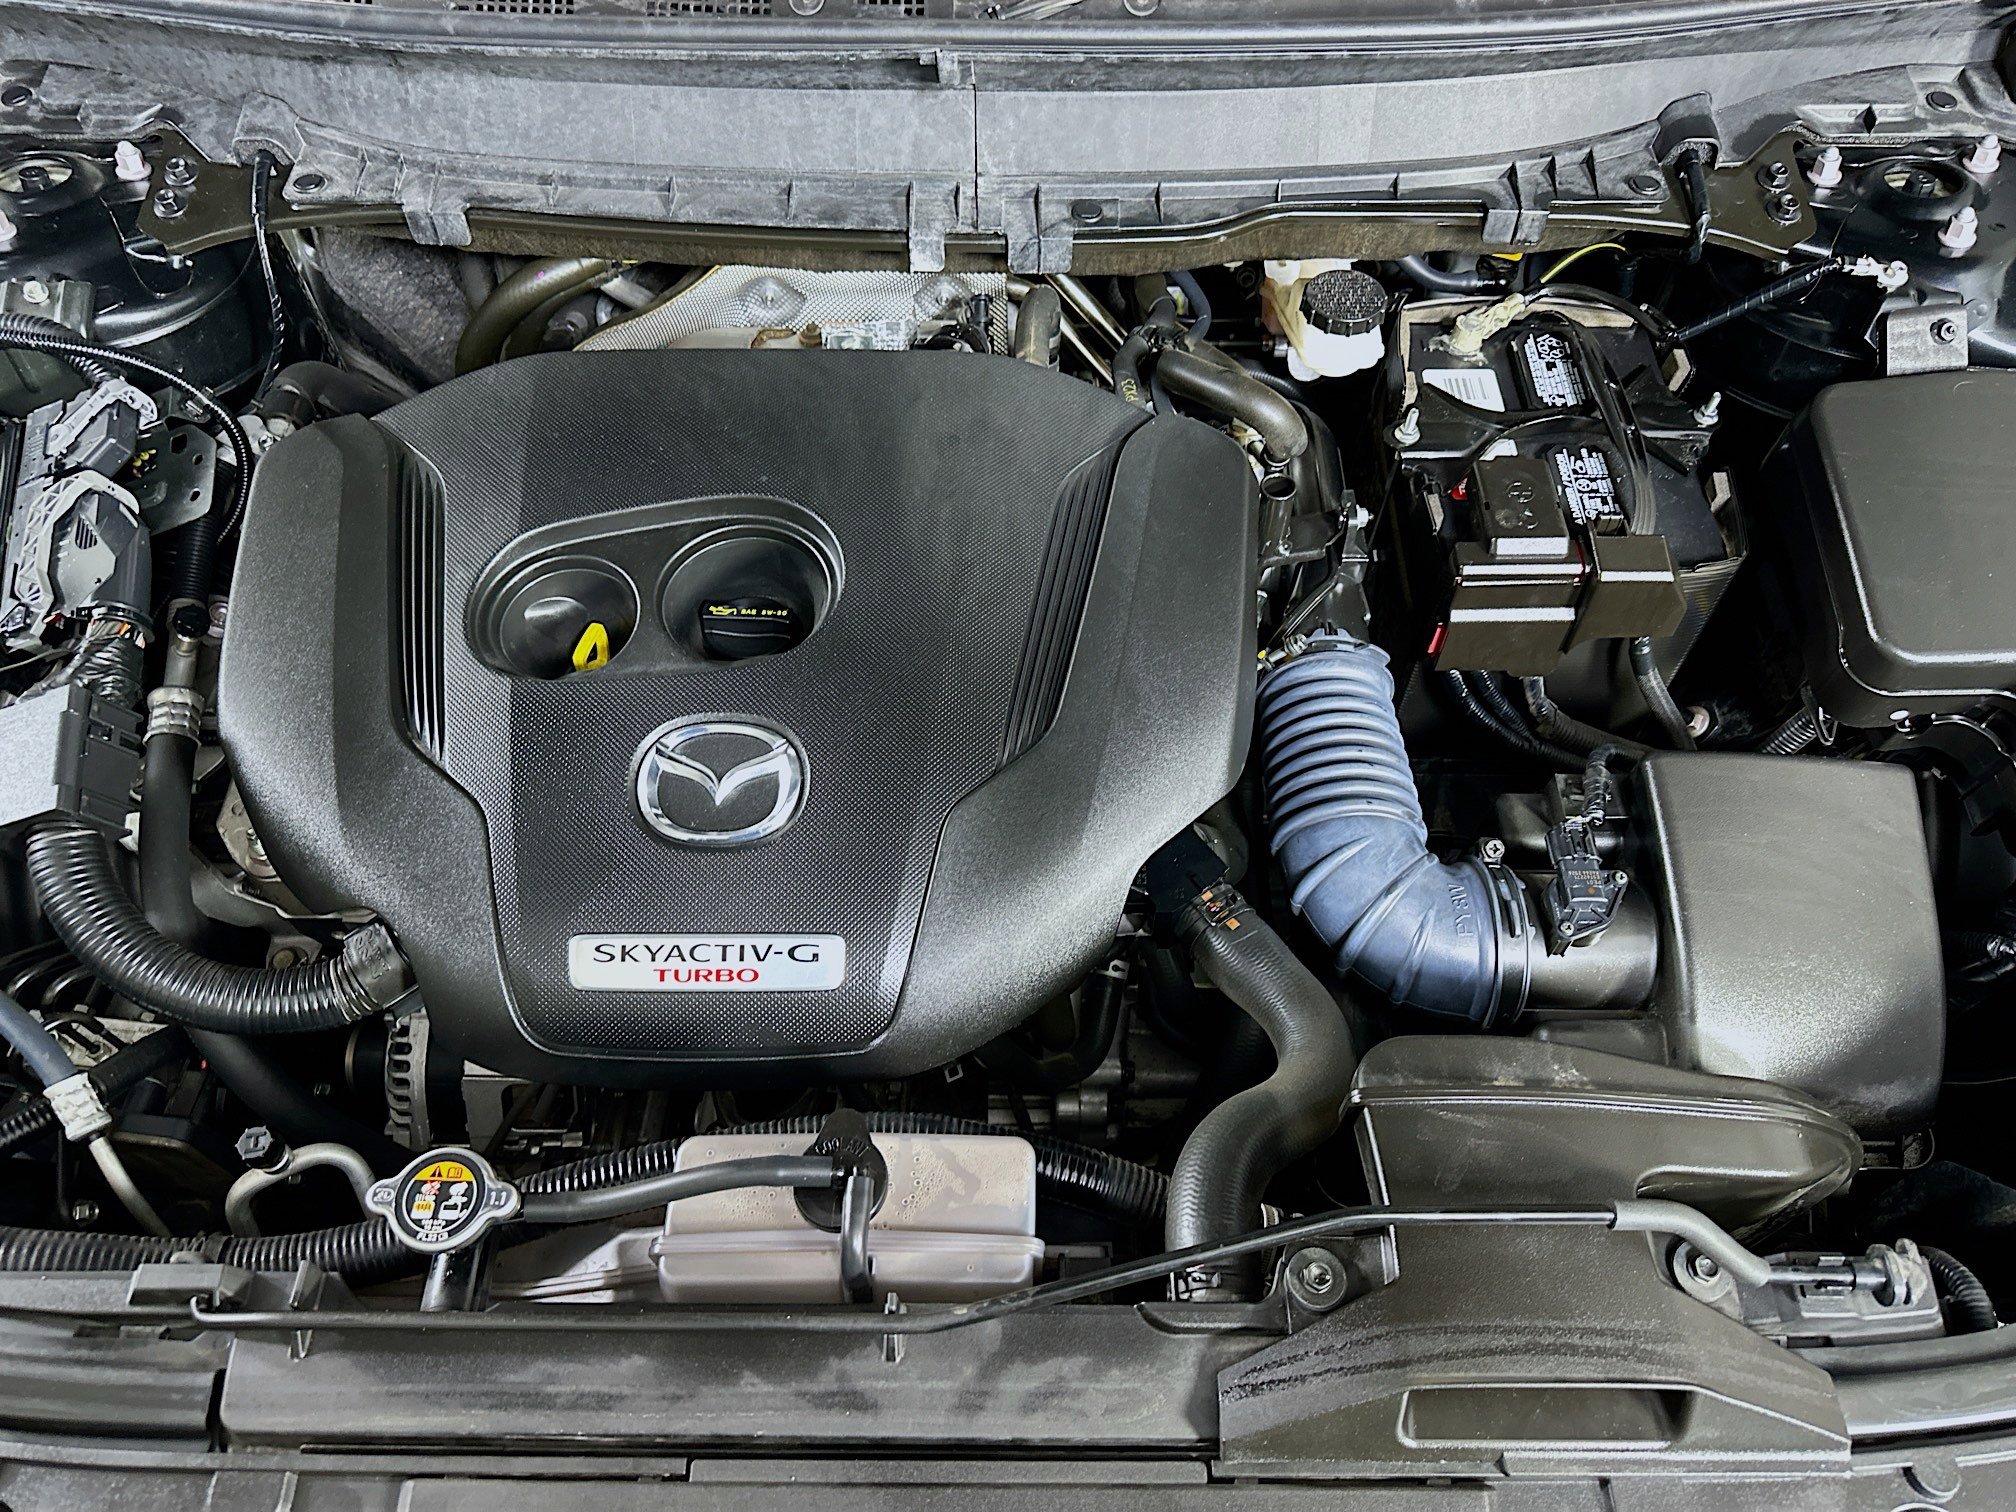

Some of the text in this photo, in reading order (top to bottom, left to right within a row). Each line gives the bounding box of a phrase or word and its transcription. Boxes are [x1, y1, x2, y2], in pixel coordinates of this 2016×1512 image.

[593, 943, 820, 963] SKYACTIV-G
[652, 968, 760, 983] TURBO
[489, 1191, 507, 1206] 1.1
